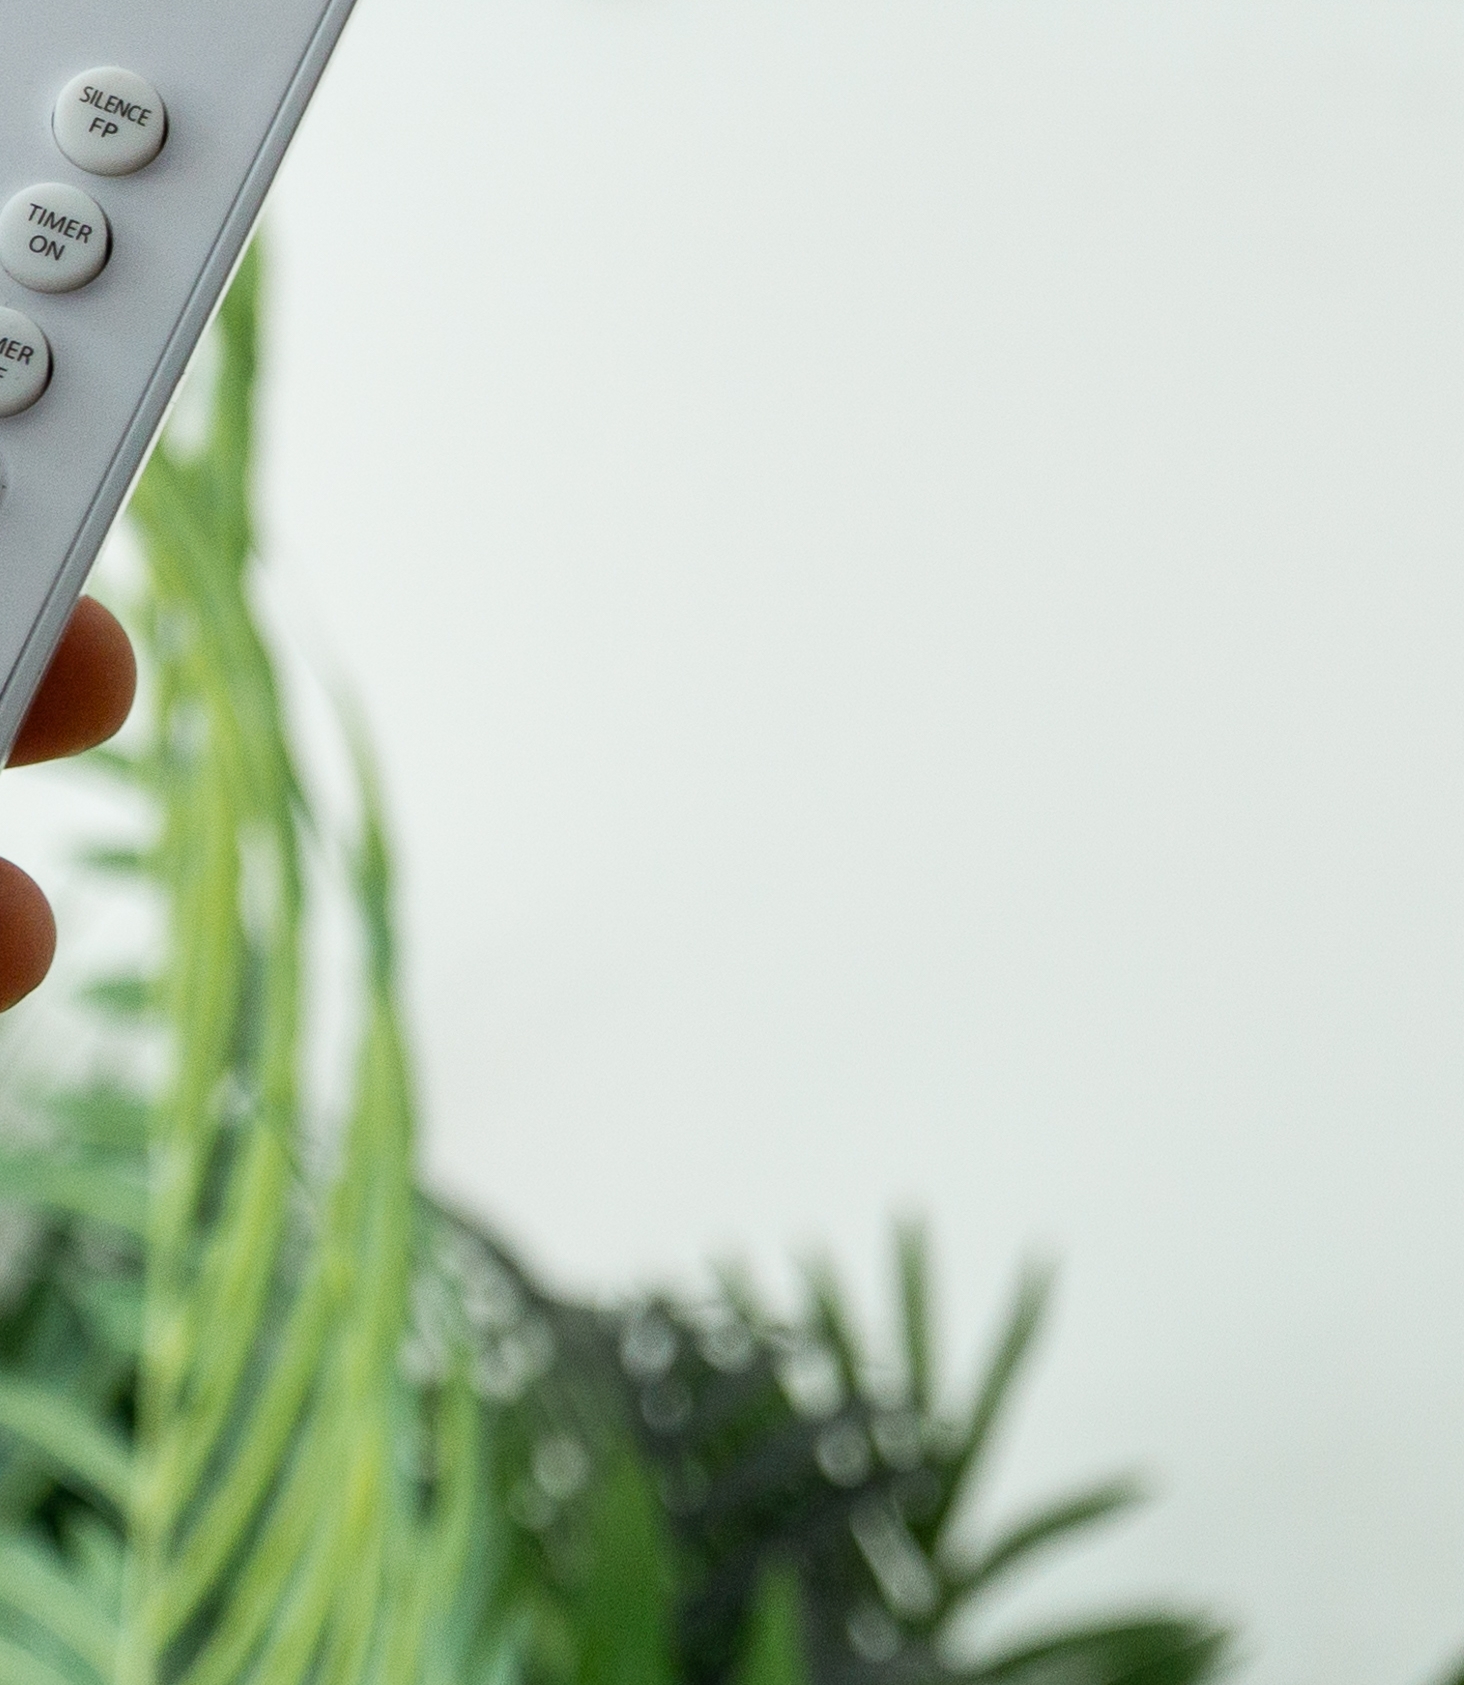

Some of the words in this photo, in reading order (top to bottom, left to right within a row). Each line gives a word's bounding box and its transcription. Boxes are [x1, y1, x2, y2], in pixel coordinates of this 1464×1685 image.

[79, 84, 152, 128] SILENCE
[88, 117, 119, 140] FP
[27, 203, 94, 245] TIMER
[28, 234, 66, 262] ON
